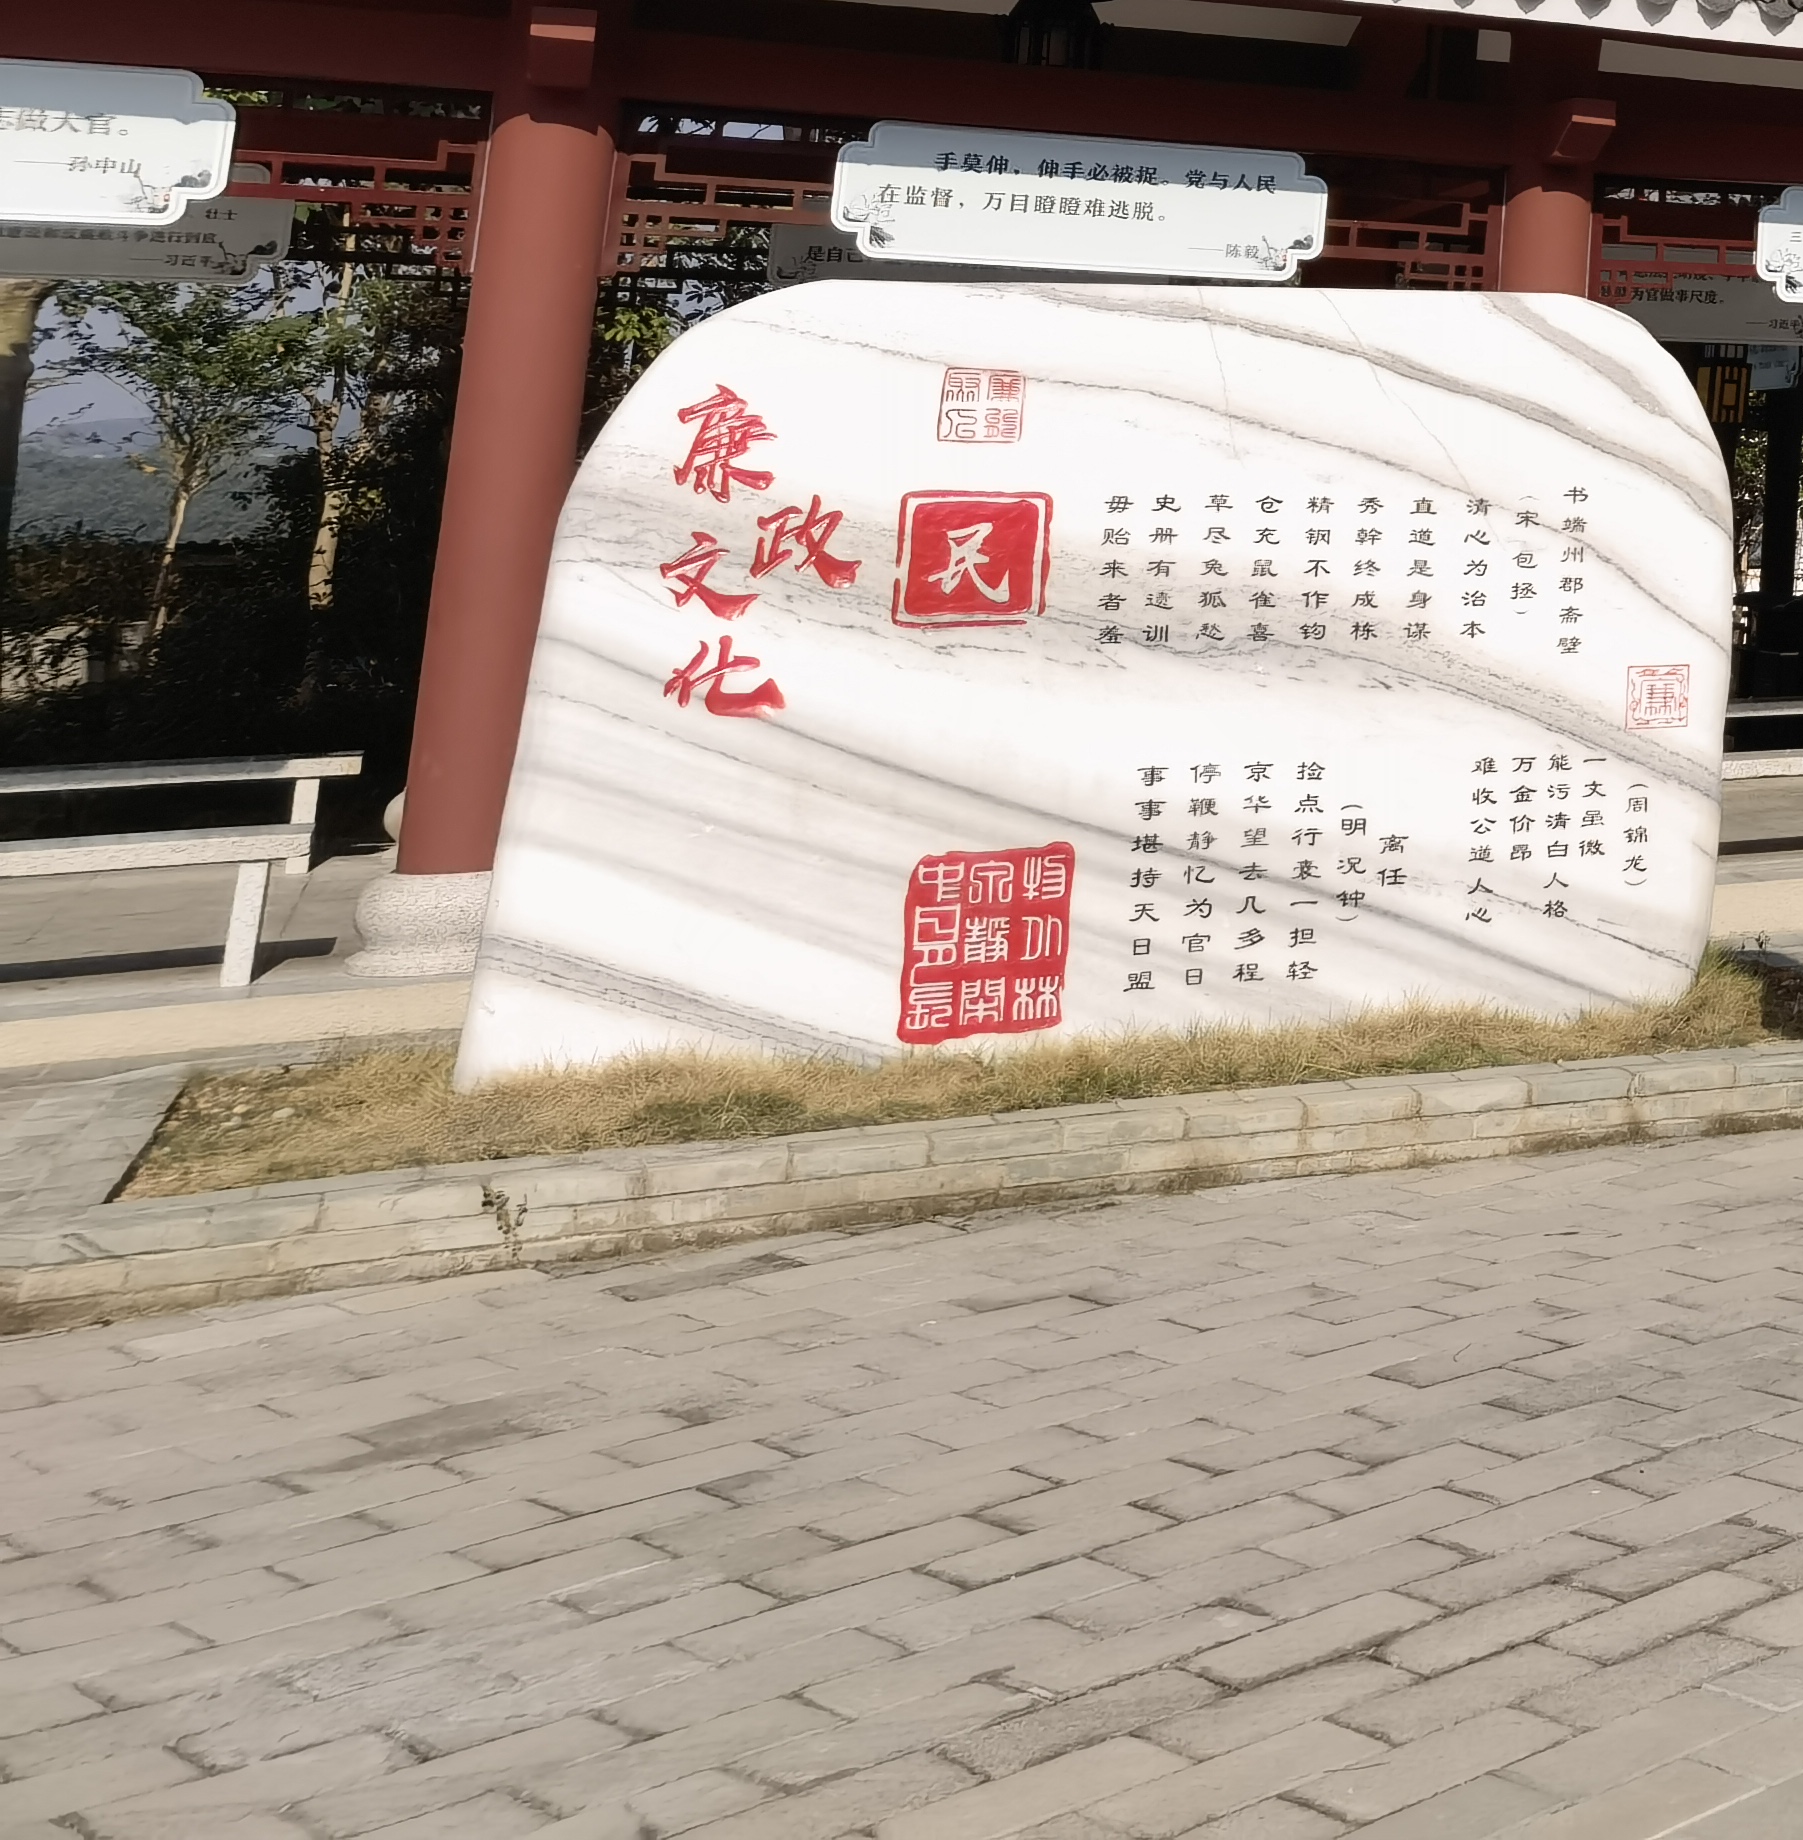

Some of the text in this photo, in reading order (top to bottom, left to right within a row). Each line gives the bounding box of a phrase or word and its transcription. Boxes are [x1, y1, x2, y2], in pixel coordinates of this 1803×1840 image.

[928, 520, 1012, 605] 民
[1094, 494, 1135, 646] 毋贻来者羞
[1141, 493, 1182, 644] 史册有遗训
[1195, 493, 1234, 642] 草尽兔狐愁
[1246, 494, 1284, 643] 仓充鼠雀喜
[1402, 496, 1438, 642] 直道是身谋
[1459, 497, 1493, 640] 清心为治本
[1556, 485, 1589, 656] 书端州郡斋壁
[1122, 764, 1170, 993] 事事堪持天日盟
[1181, 762, 1222, 986] 停鞭静忆为官日
[1231, 760, 1275, 983] 京华望去几多程
[1376, 833, 1410, 888] 离任
[1464, 755, 1499, 924] 难收公道人心
[1508, 755, 1538, 862] 万金价昂
[1542, 753, 1573, 919] 能污清白人格
[1578, 756, 1607, 858] 一文虽微
